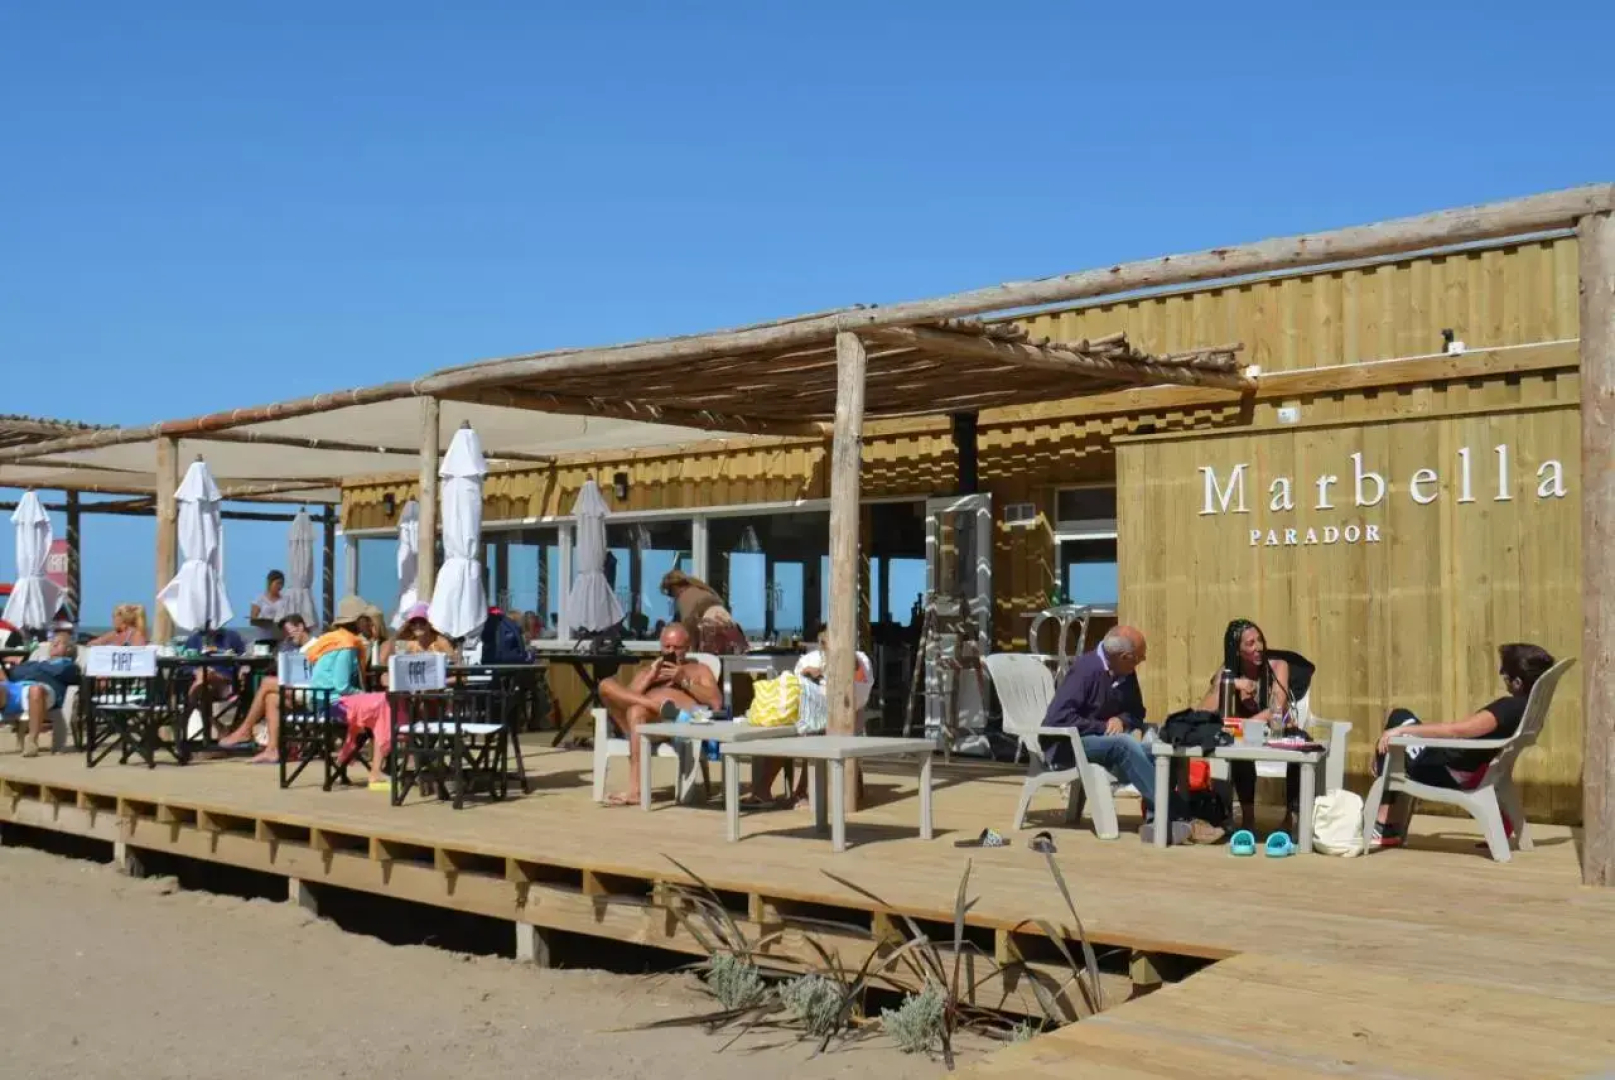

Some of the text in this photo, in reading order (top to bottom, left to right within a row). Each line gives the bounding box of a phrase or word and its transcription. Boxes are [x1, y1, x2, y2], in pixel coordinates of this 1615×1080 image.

[1199, 444, 1568, 515] Marbella
[1249, 524, 1380, 546] PARADOR
[111, 651, 133, 671] FIAT
[408, 660, 426, 684] FIAT
